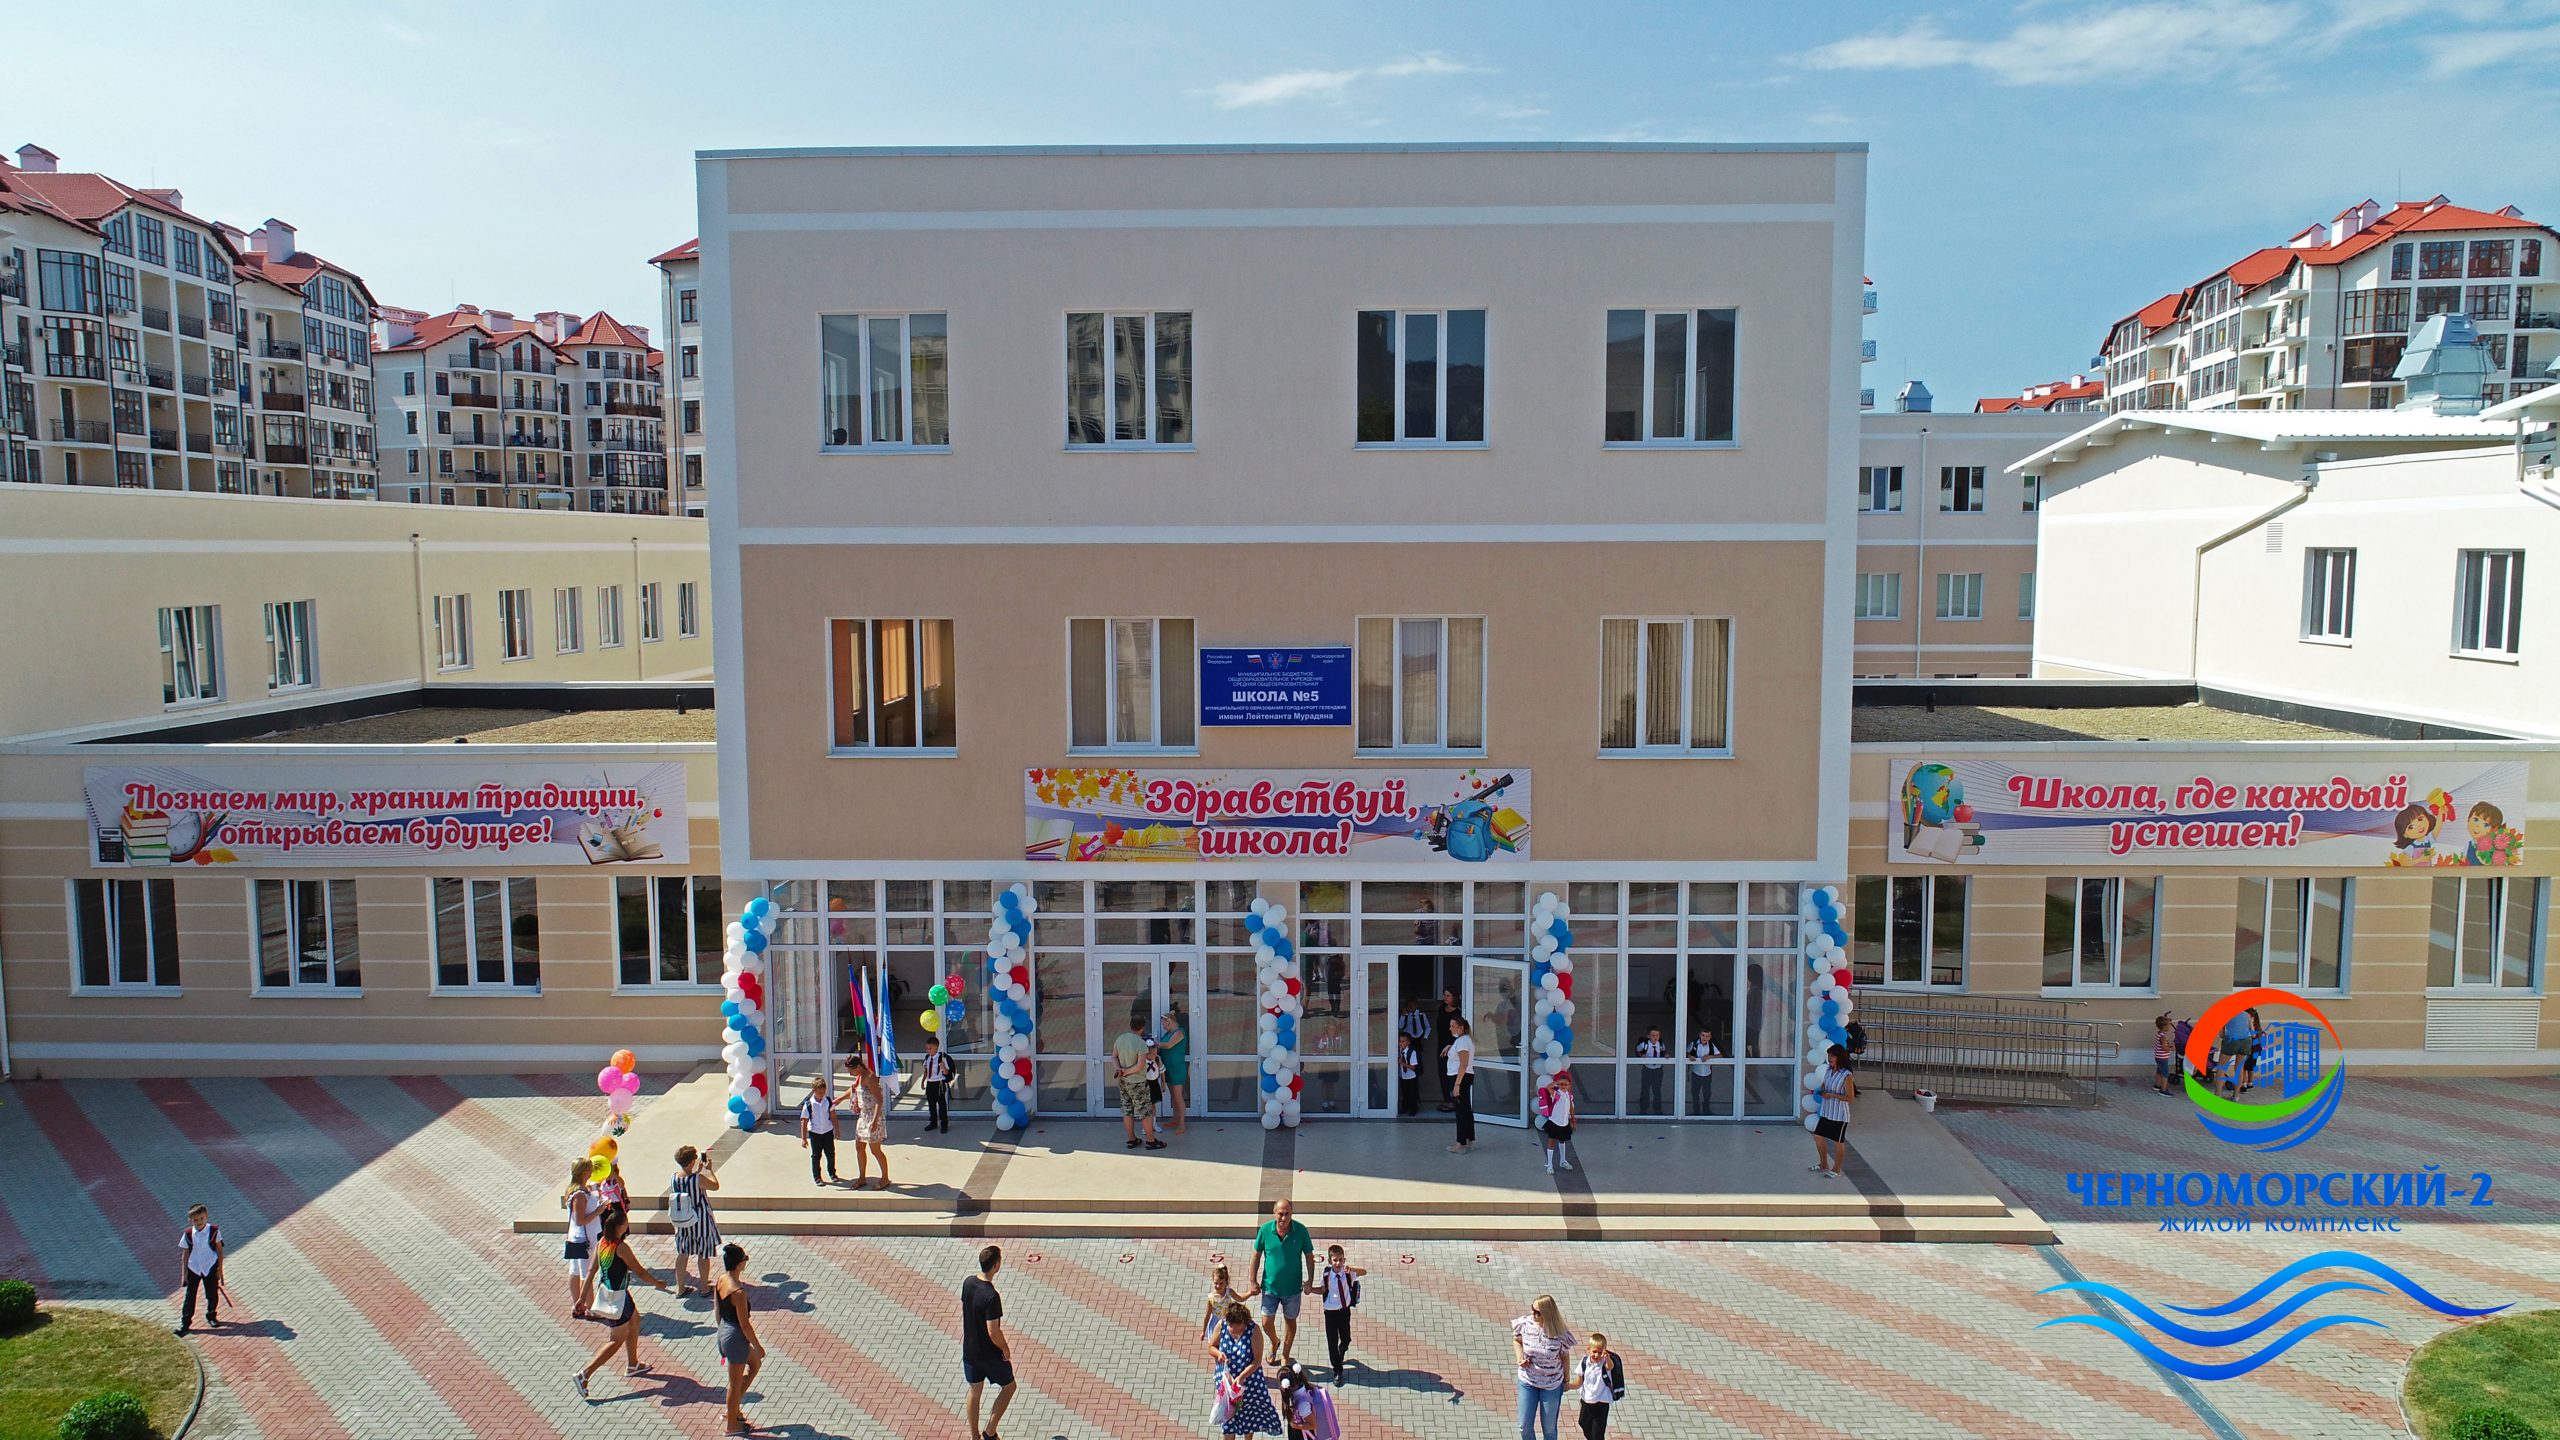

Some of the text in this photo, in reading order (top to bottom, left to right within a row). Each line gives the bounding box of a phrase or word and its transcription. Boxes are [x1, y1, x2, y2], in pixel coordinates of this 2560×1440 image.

[1232, 690, 1320, 702] ШКОЛА №5
[1245, 712, 1292, 720] Лейтенанта
[1293, 712, 1334, 721] Мурадяна
[2007, 774, 2408, 812] Школа, где каждый
[124, 783, 645, 817] Познаем мир, храним традиции,
[1146, 780, 1418, 823] Здравствуй,
[219, 817, 552, 851] открываем будущее!
[1201, 822, 1351, 855] школа!
[2110, 814, 2301, 855] успешен!
[1026, 1253, 1042, 1264] 5
[1119, 1252, 1135, 1264] 5
[1209, 1252, 1225, 1264] 5
[1401, 1253, 1416, 1265] 5
[1476, 1253, 1490, 1264] 5
